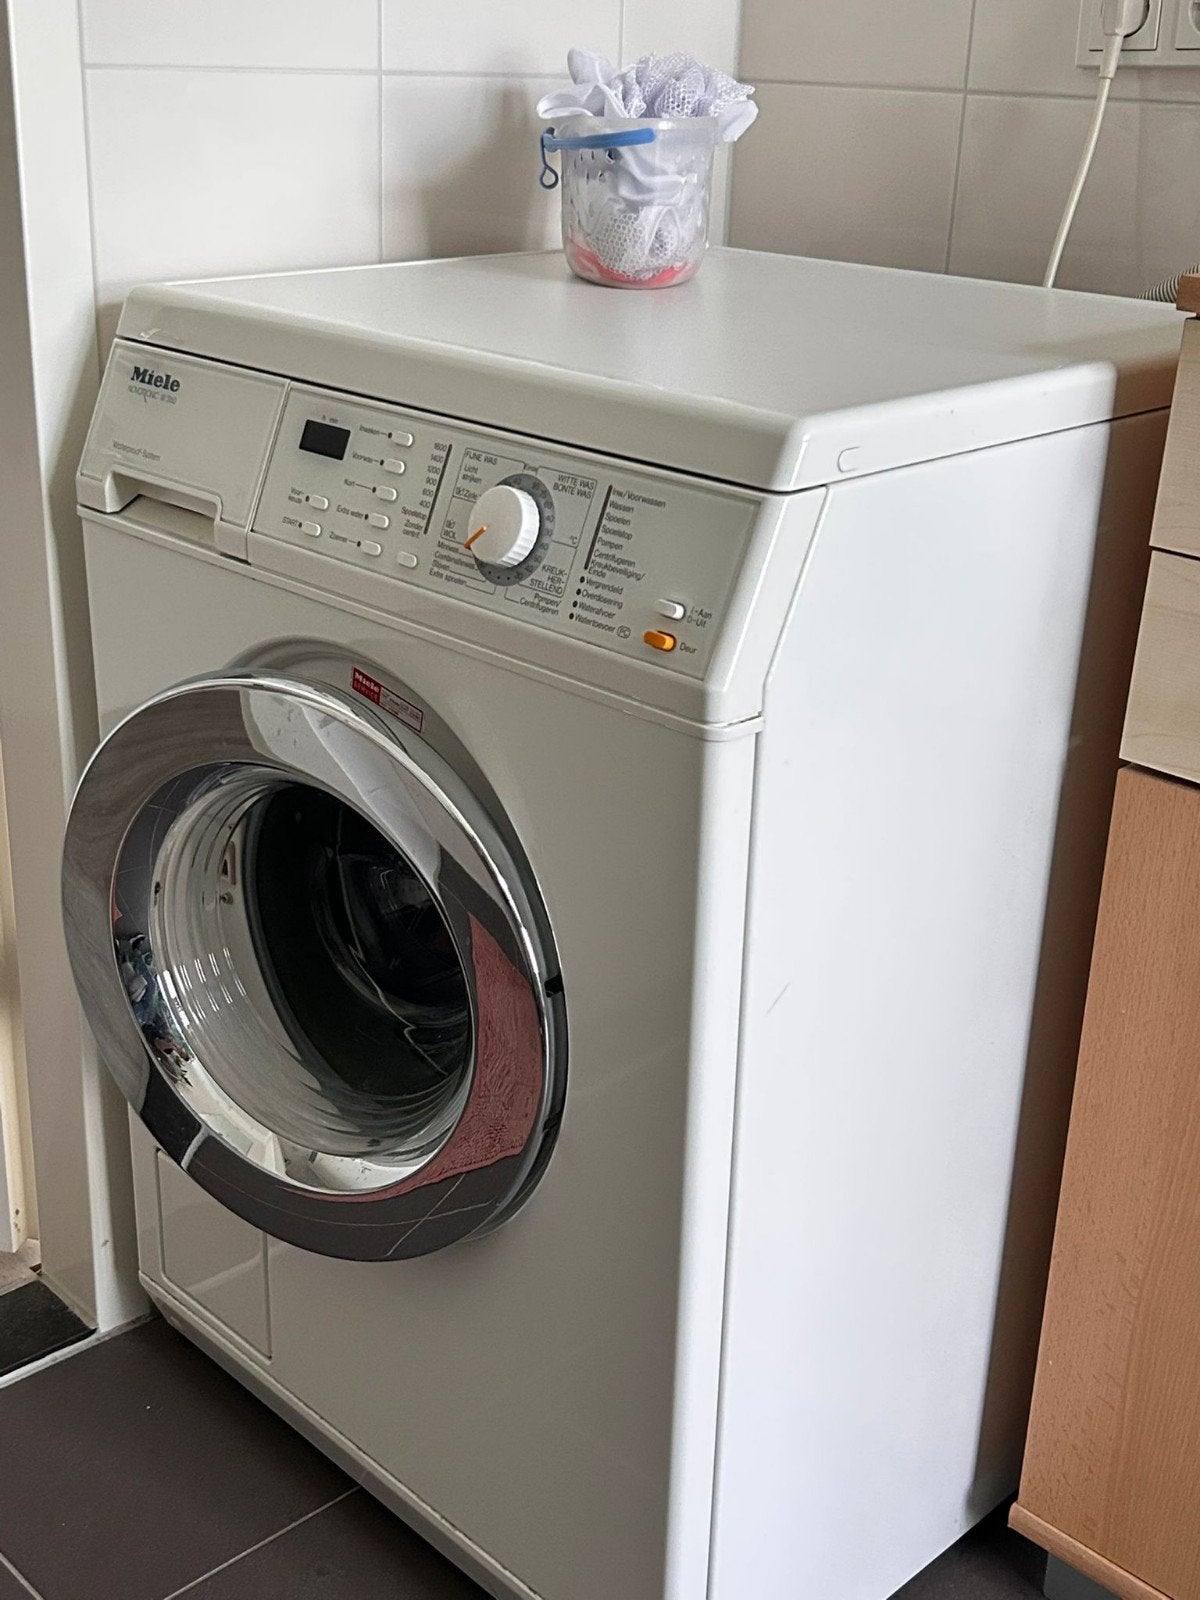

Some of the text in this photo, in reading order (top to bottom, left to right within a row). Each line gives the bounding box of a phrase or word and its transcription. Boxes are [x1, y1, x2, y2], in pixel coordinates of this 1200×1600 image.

[131, 366, 180, 392] Miele
[483, 455, 498, 466] WAS
[553, 482, 592, 500] BONTE WAS
[558, 474, 595, 491] WITTE WAS
[419, 499, 431, 509] 400
[610, 500, 634, 513] Wassen
[604, 512, 631, 527] Spoelen
[600, 524, 633, 541] Spoelstop
[597, 536, 623, 551] Pompen
[594, 549, 636, 568] Centrifugeren
[542, 563, 567, 577] KREUK-
[588, 566, 607, 579] Einde
[530, 578, 563, 595] STELLEND
[547, 575, 565, 585] HER-
[585, 577, 624, 595] Vergrendeld
[520, 597, 560, 616] Centrifugeren
[581, 589, 624, 610] Overdosering
[578, 601, 617, 619] Waterafvoer
[574, 613, 616, 633] Watertoevoer
[680, 642, 698, 654] Deur
[354, 670, 380, 693] Miele
